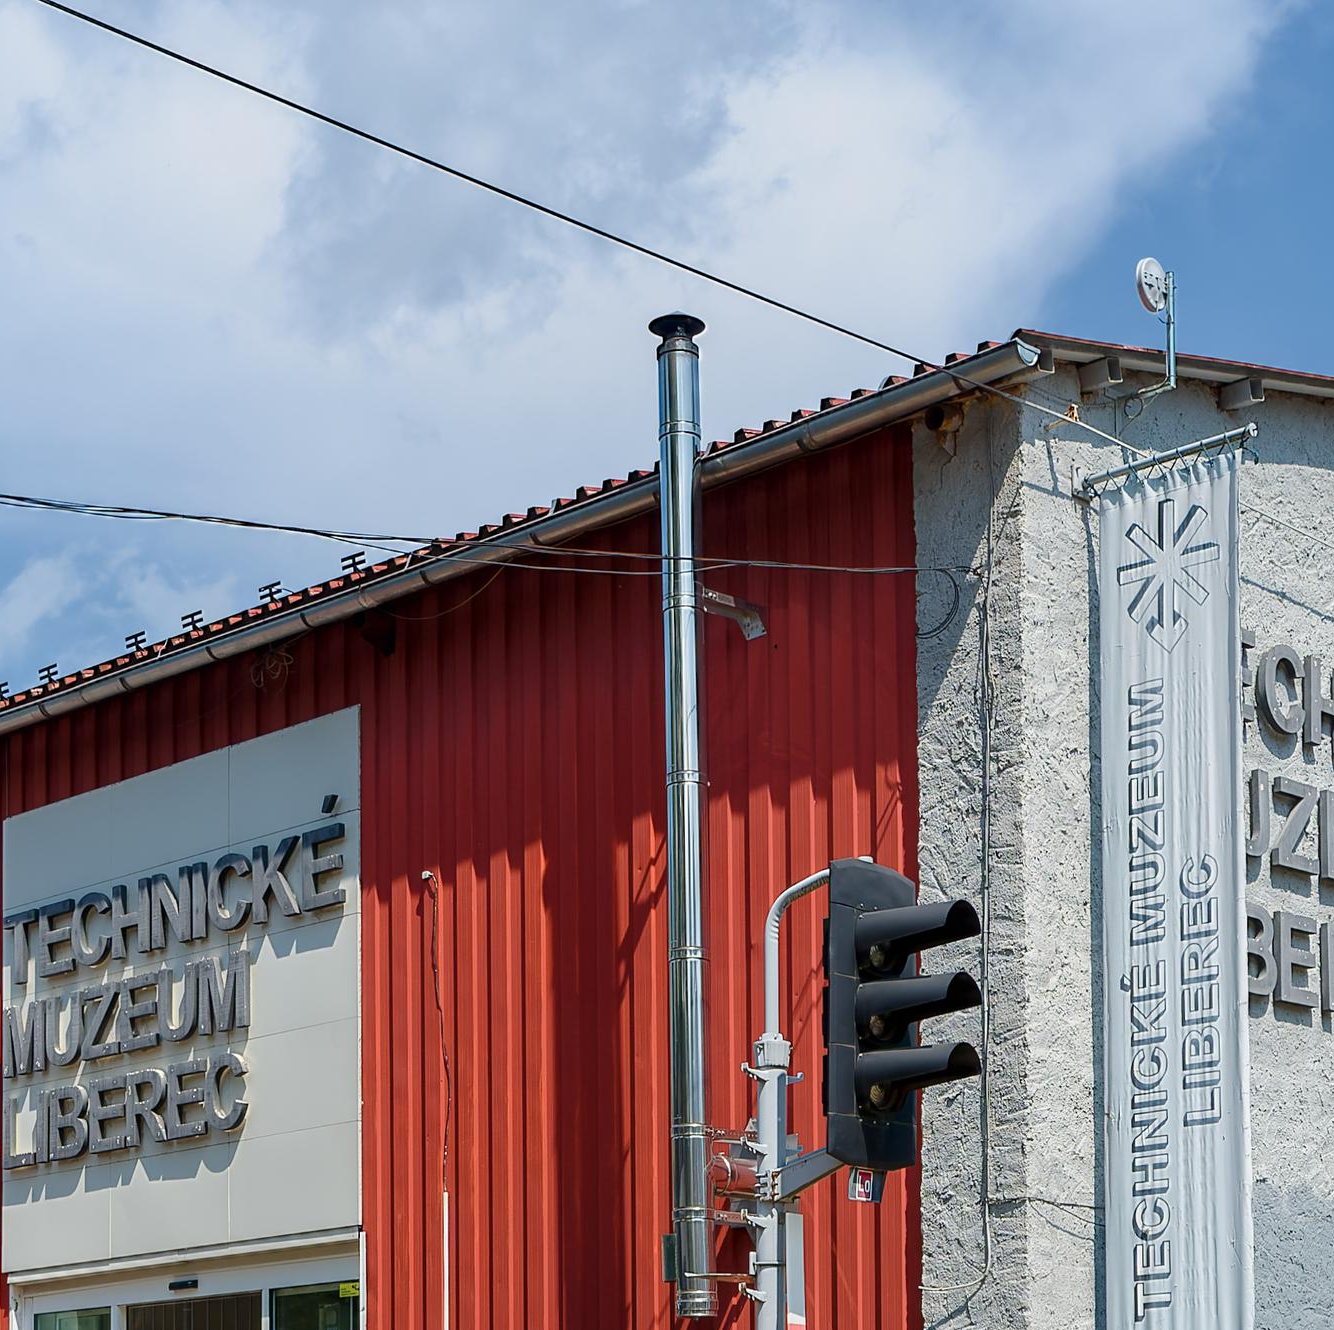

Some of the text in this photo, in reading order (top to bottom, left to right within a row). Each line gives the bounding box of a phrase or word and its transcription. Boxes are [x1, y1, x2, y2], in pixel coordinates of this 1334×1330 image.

[3, 793, 347, 985] TECHNICKÉ
[2, 950, 251, 1079] MUZEUM
[1119, 677, 1172, 1323] TECHNICKÉ MUZEUM
[1178, 853, 1222, 1128] LIBEREC
[2, 1051, 250, 1171] LIBEREC
